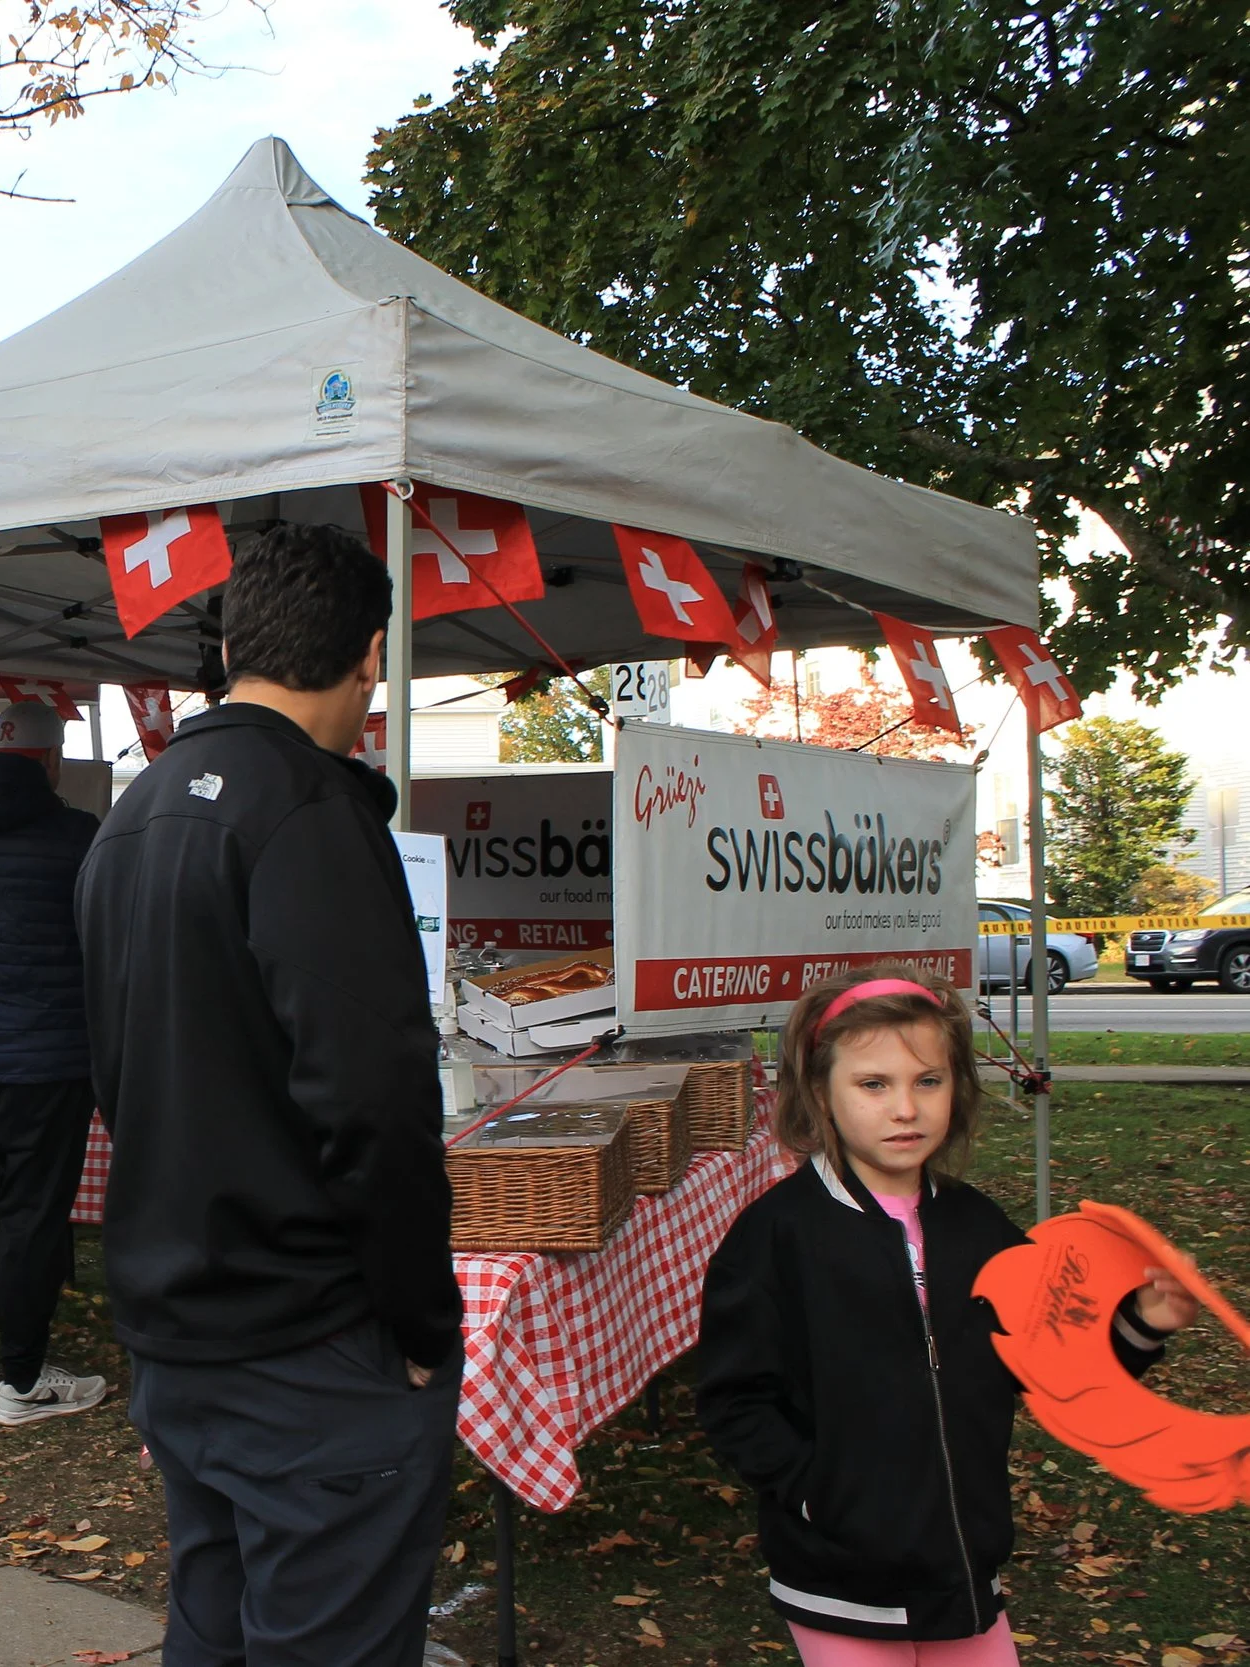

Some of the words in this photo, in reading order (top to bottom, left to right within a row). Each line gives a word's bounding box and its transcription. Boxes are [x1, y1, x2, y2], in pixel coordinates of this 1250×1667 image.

[647, 670, 668, 713] 28
[635, 754, 707, 832] Grüezi
[403, 854, 426, 864] Cookie
[540, 890, 561, 903] our
[563, 888, 592, 903] food
[825, 914, 841, 929] our
[842, 909, 862, 929] food
[863, 909, 891, 929] makes
[892, 914, 906, 933] you
[907, 908, 921, 929] feel
[921, 909, 942, 932] good
[1056, 920, 1117, 932] CAUTION
[1138, 917, 1200, 929] CAUTION
[518, 924, 589, 945] RETAIL
[673, 965, 770, 1000] CATERING
